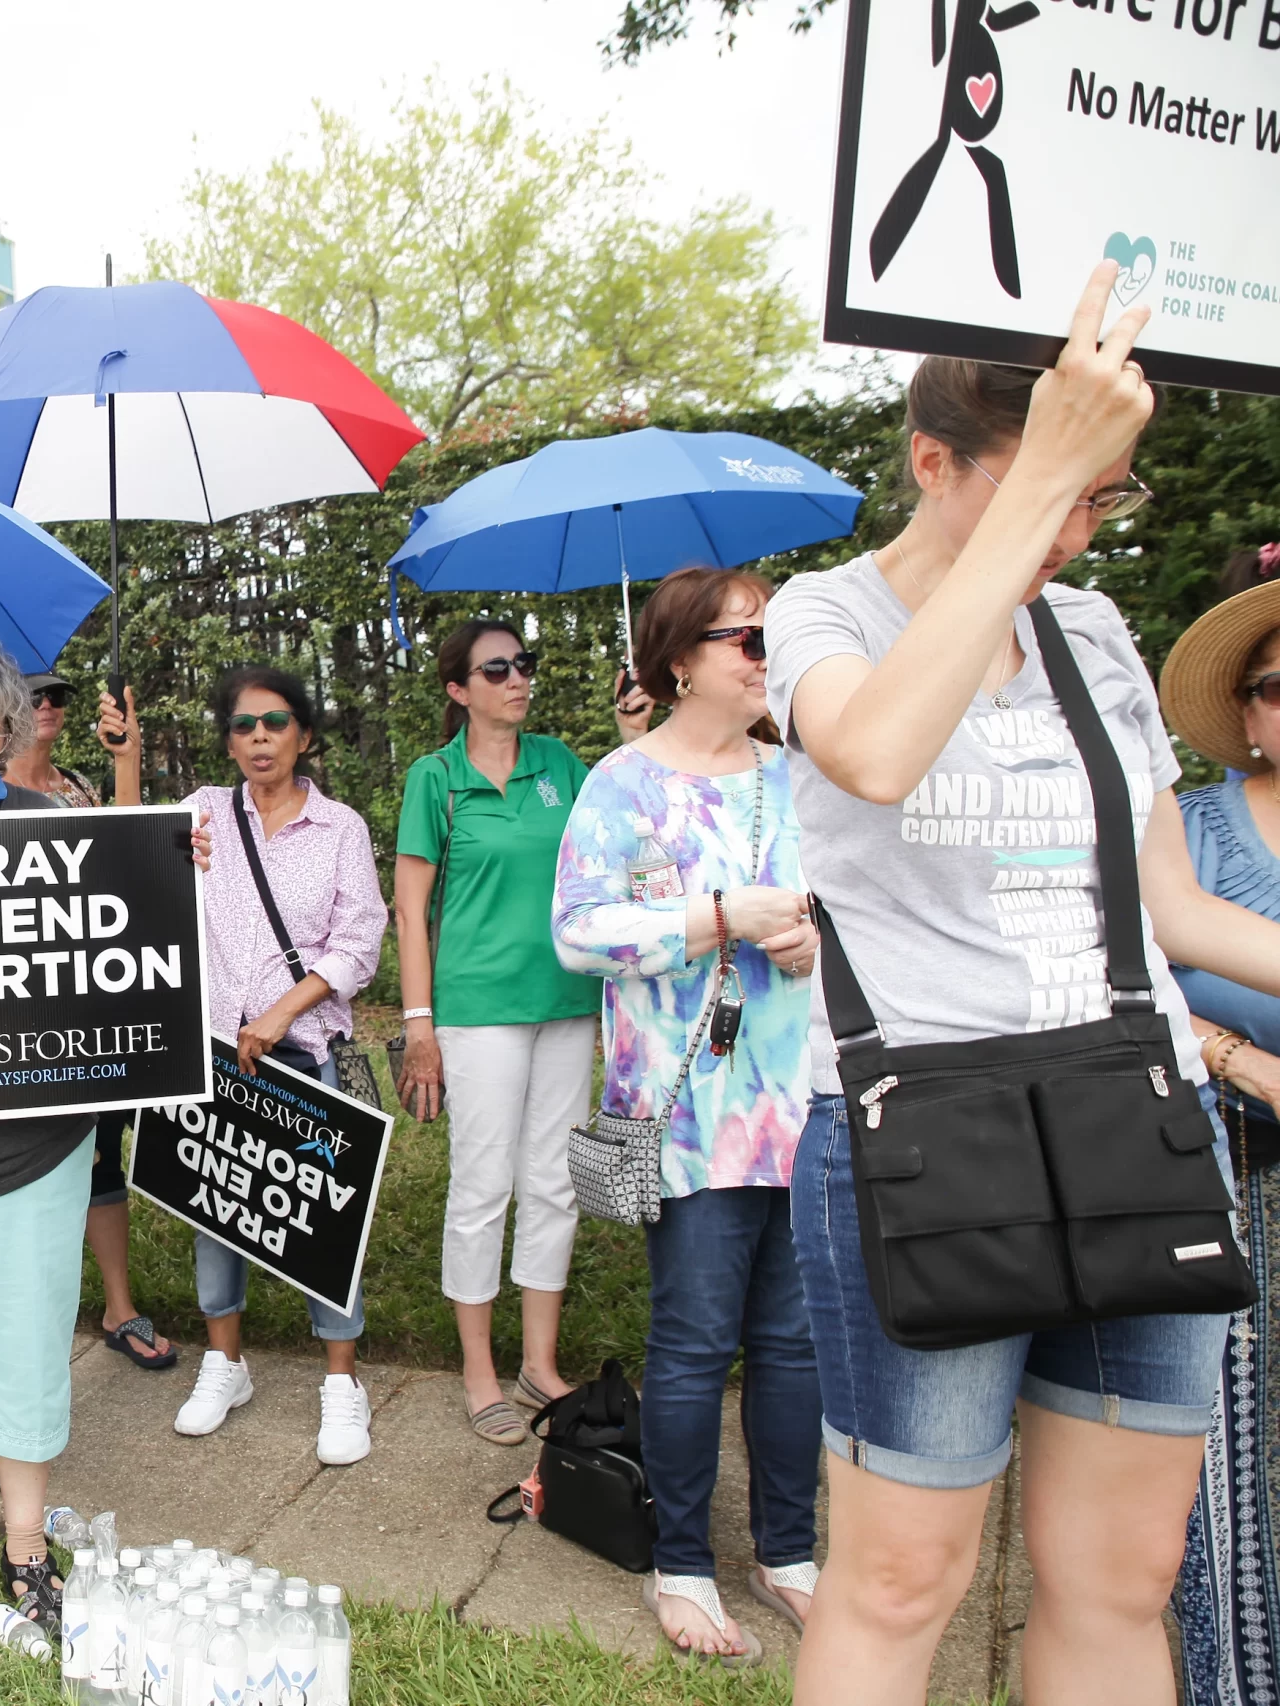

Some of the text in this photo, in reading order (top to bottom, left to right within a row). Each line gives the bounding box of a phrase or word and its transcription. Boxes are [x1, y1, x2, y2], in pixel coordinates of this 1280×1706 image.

[1067, 67, 1118, 120] No
[1128, 80, 1246, 146] Matter
[1169, 241, 1196, 262] THE
[1165, 268, 1236, 297] HOUSTON
[1161, 297, 1225, 322] FOR LIFE
[975, 710, 1056, 746] WAS
[902, 773, 991, 816] AND
[1001, 776, 1082, 817] NOW
[901, 818, 1051, 846] COMPLETELY
[989, 868, 1090, 890] AND THE
[988, 889, 1046, 912] THING
[1, 893, 129, 944] END
[997, 907, 1097, 937] HAPPENED
[17, 1029, 100, 1062] FOR
[212, 1070, 352, 1157] 40 DAYS FOR
[177, 1137, 313, 1236] TO END
[188, 1182, 287, 1257] PRAY
